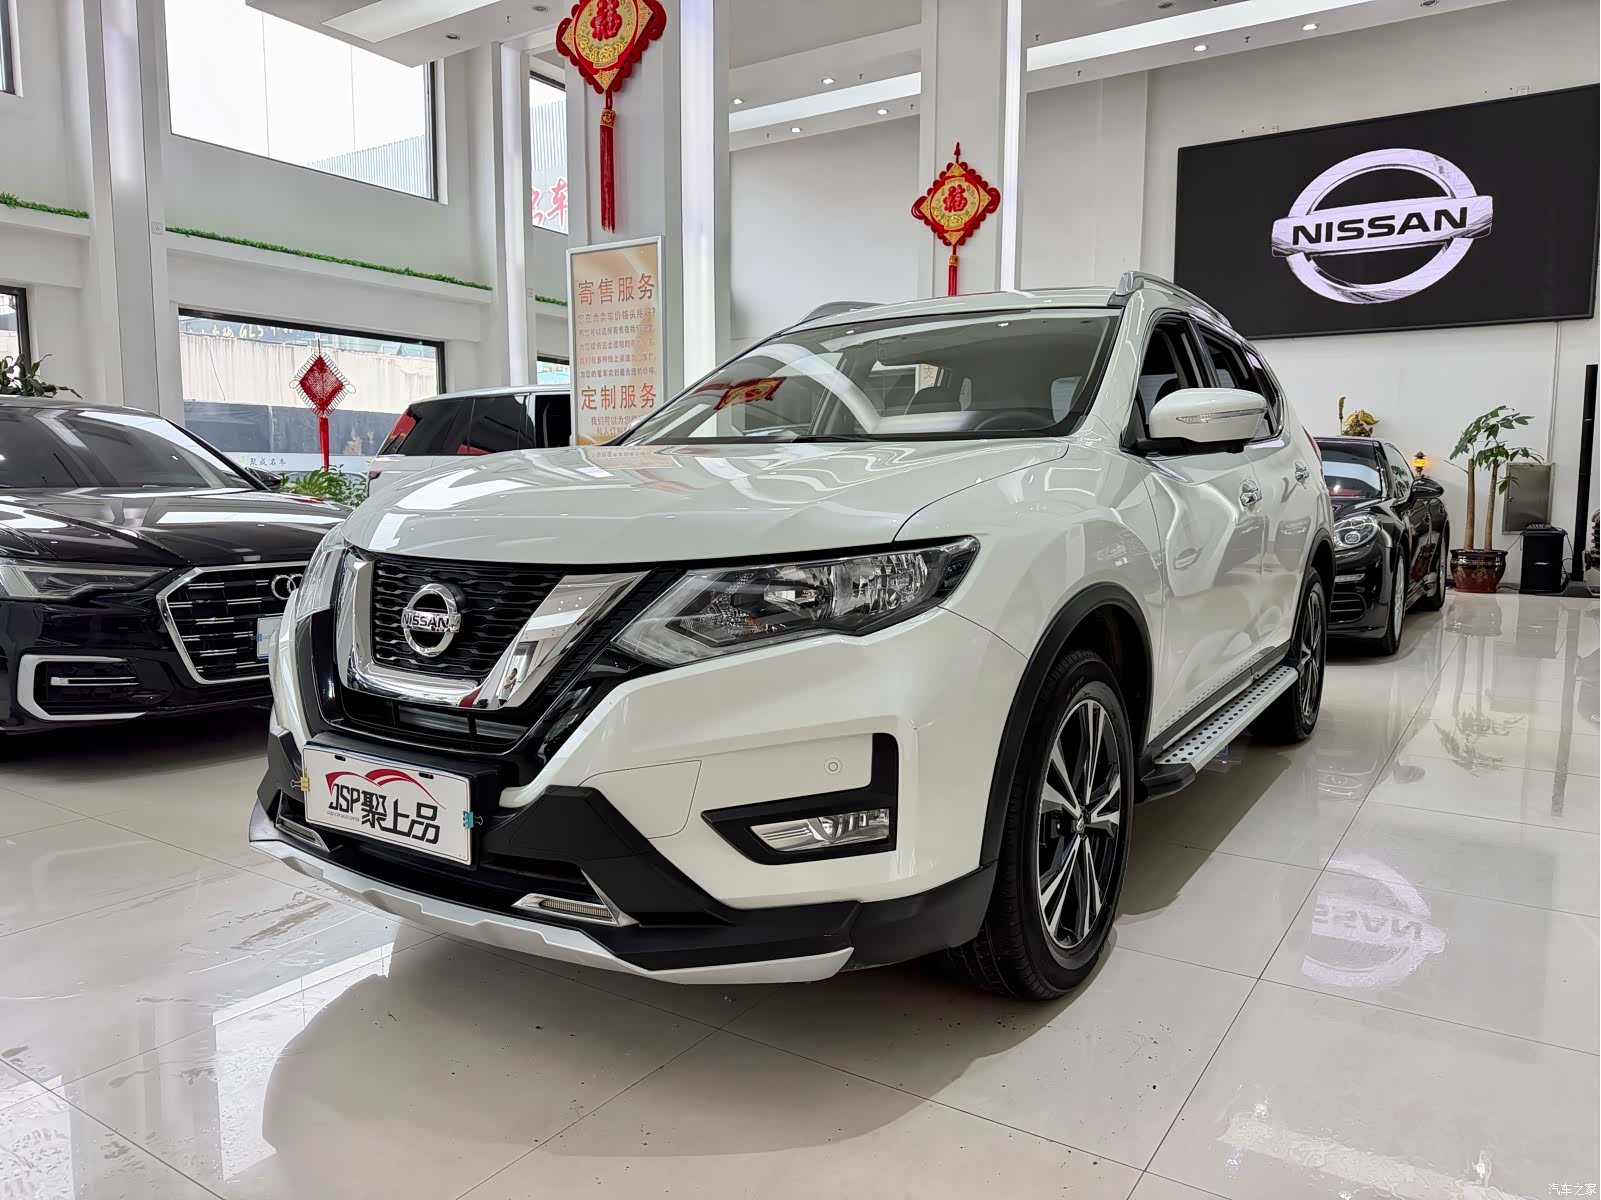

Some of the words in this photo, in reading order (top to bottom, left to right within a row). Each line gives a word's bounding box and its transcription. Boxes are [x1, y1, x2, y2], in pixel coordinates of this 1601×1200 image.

[943, 184, 968, 213] 福
[1292, 207, 1468, 245] NISSAN
[578, 272, 655, 306] 寄售服务
[581, 382, 657, 411] 定制服务
[402, 613, 449, 629] NISSAN
